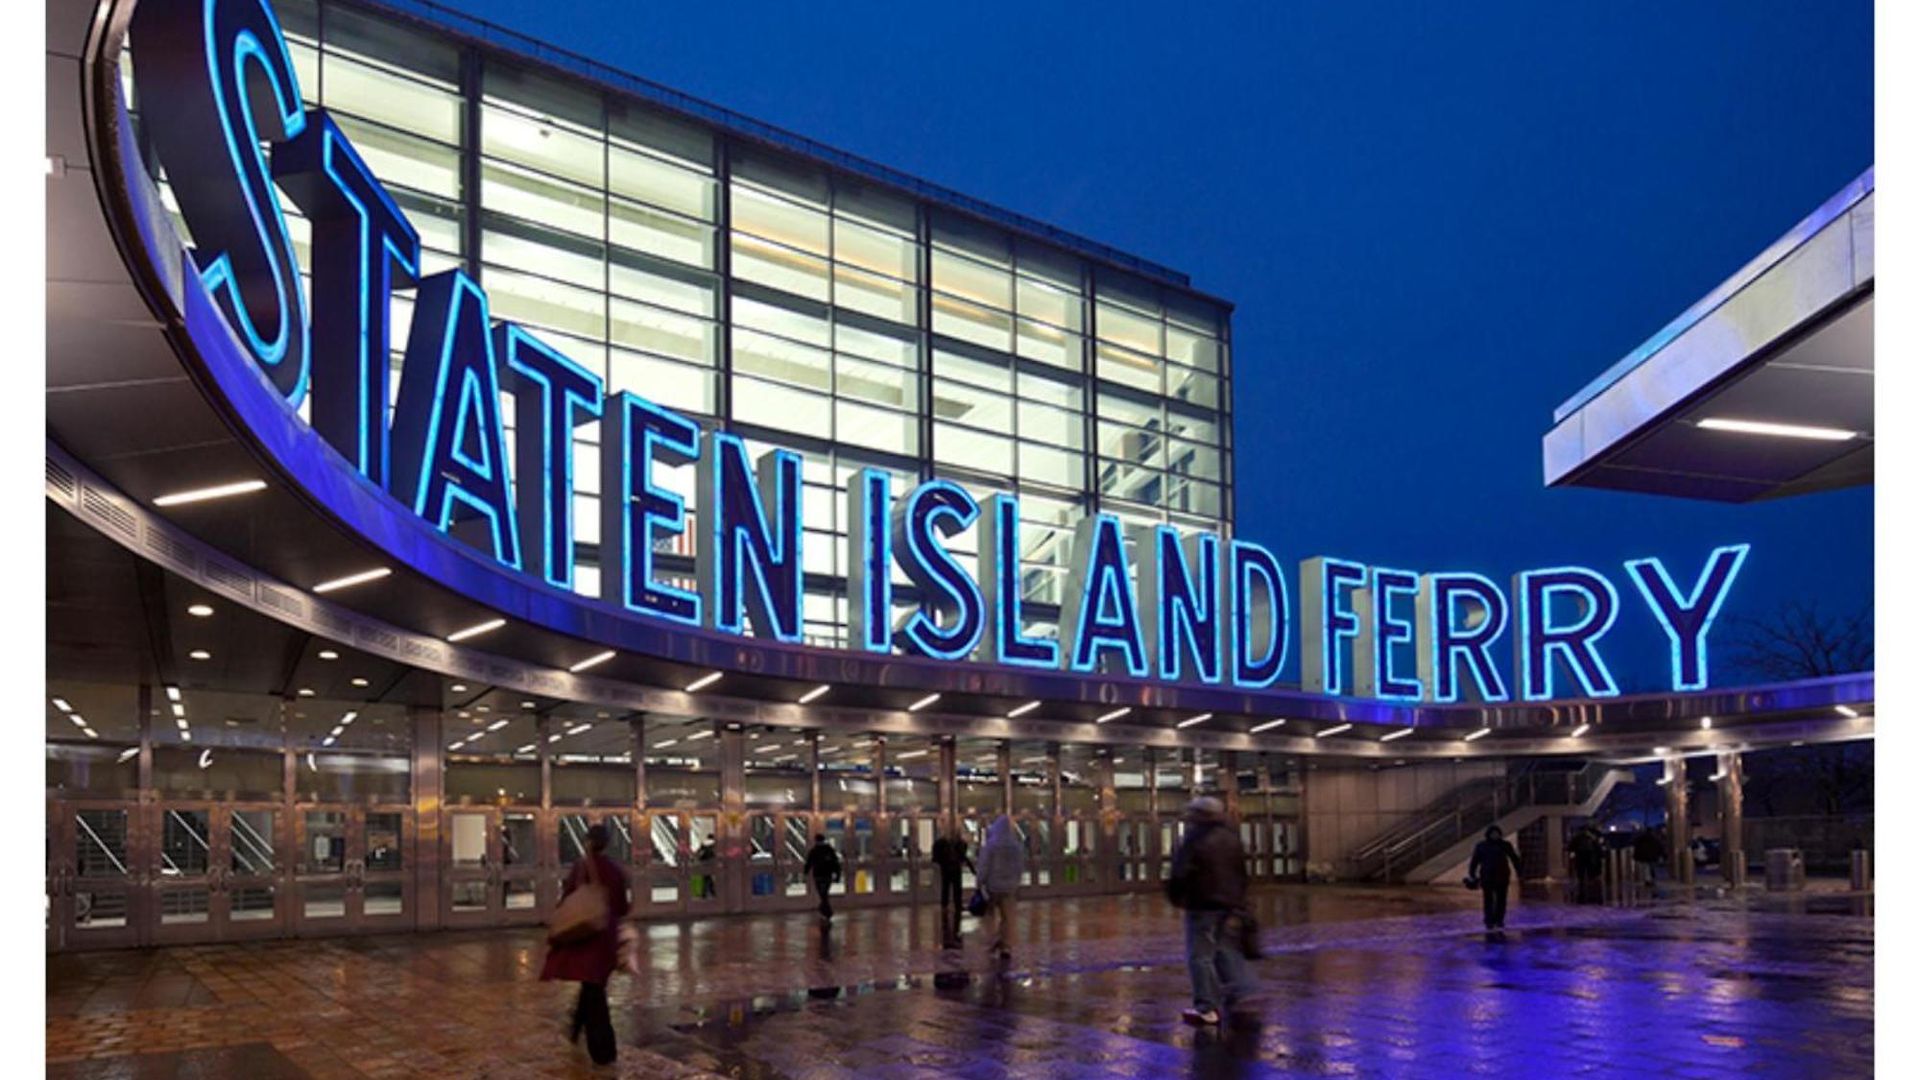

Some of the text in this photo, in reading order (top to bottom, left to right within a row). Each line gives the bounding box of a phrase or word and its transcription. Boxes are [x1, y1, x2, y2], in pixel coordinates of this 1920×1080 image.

[197, 0, 1751, 702] STATEN ISLAND FERRY
